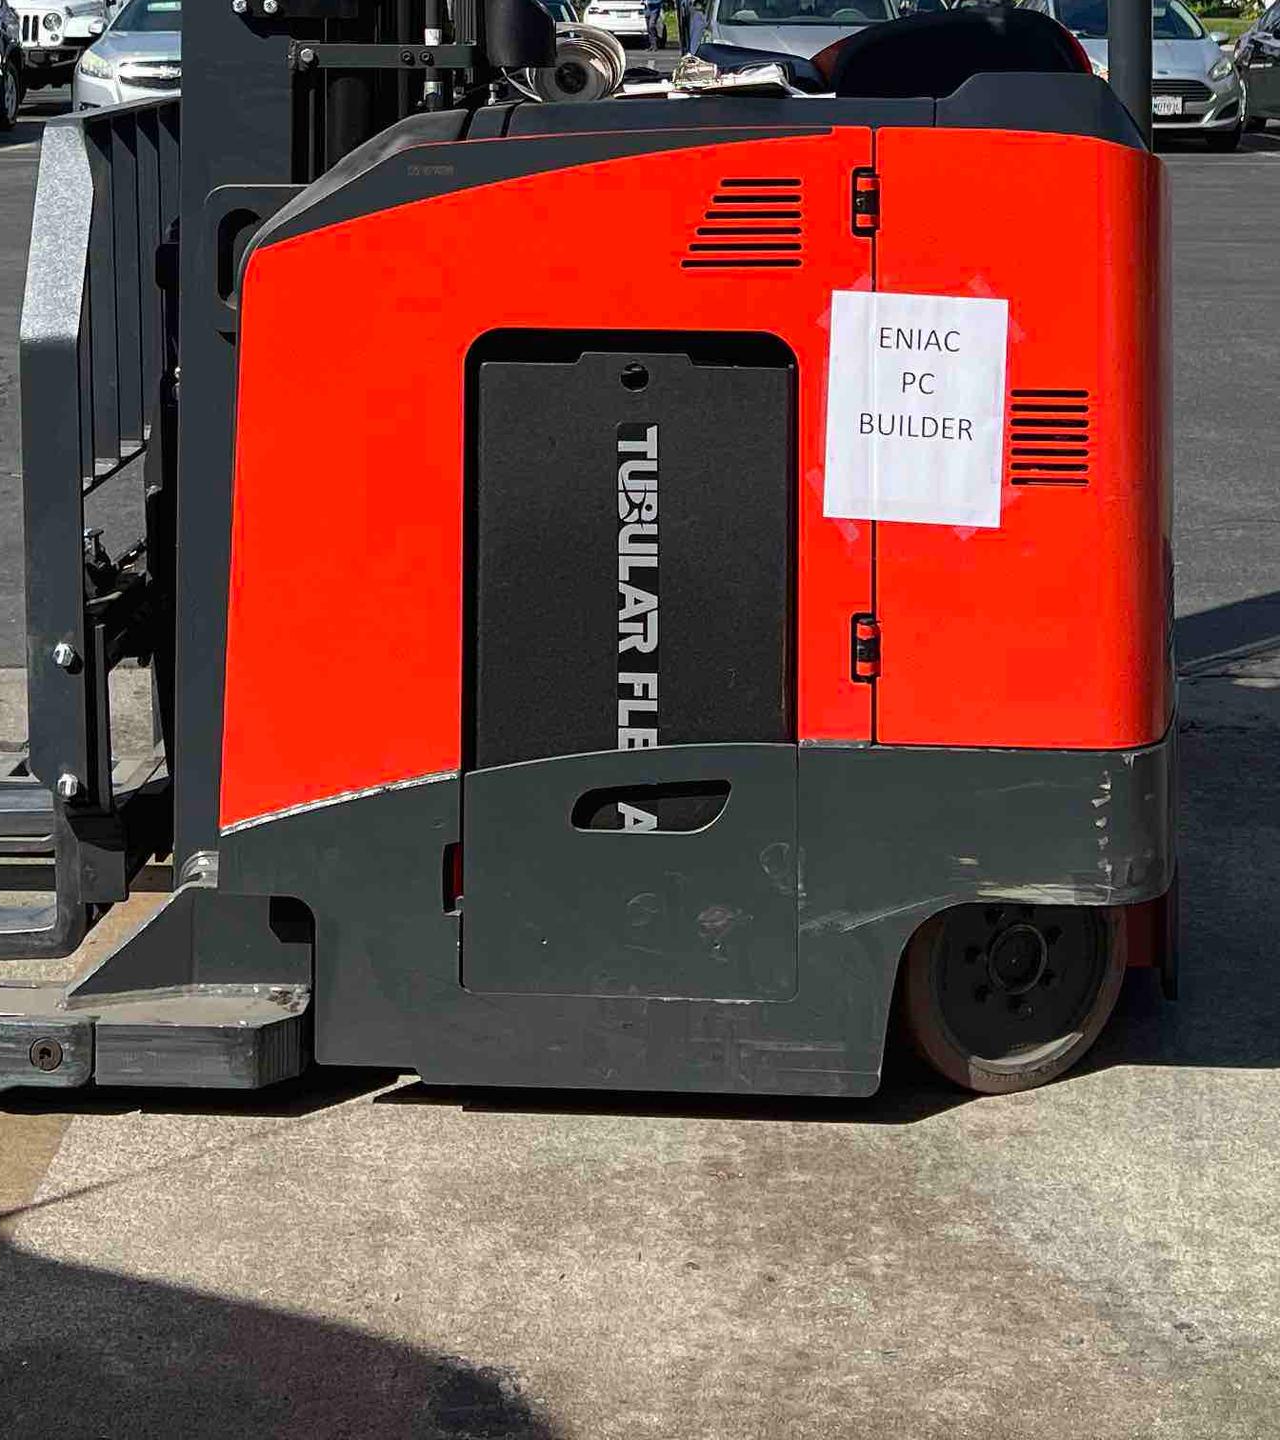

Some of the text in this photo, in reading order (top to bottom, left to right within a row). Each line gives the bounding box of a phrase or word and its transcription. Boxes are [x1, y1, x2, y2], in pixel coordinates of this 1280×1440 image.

[879, 327, 961, 352] ENIAC
[901, 371, 936, 395] PC
[860, 412, 974, 441] BUILDER
[618, 424, 658, 653] TUBULAR
